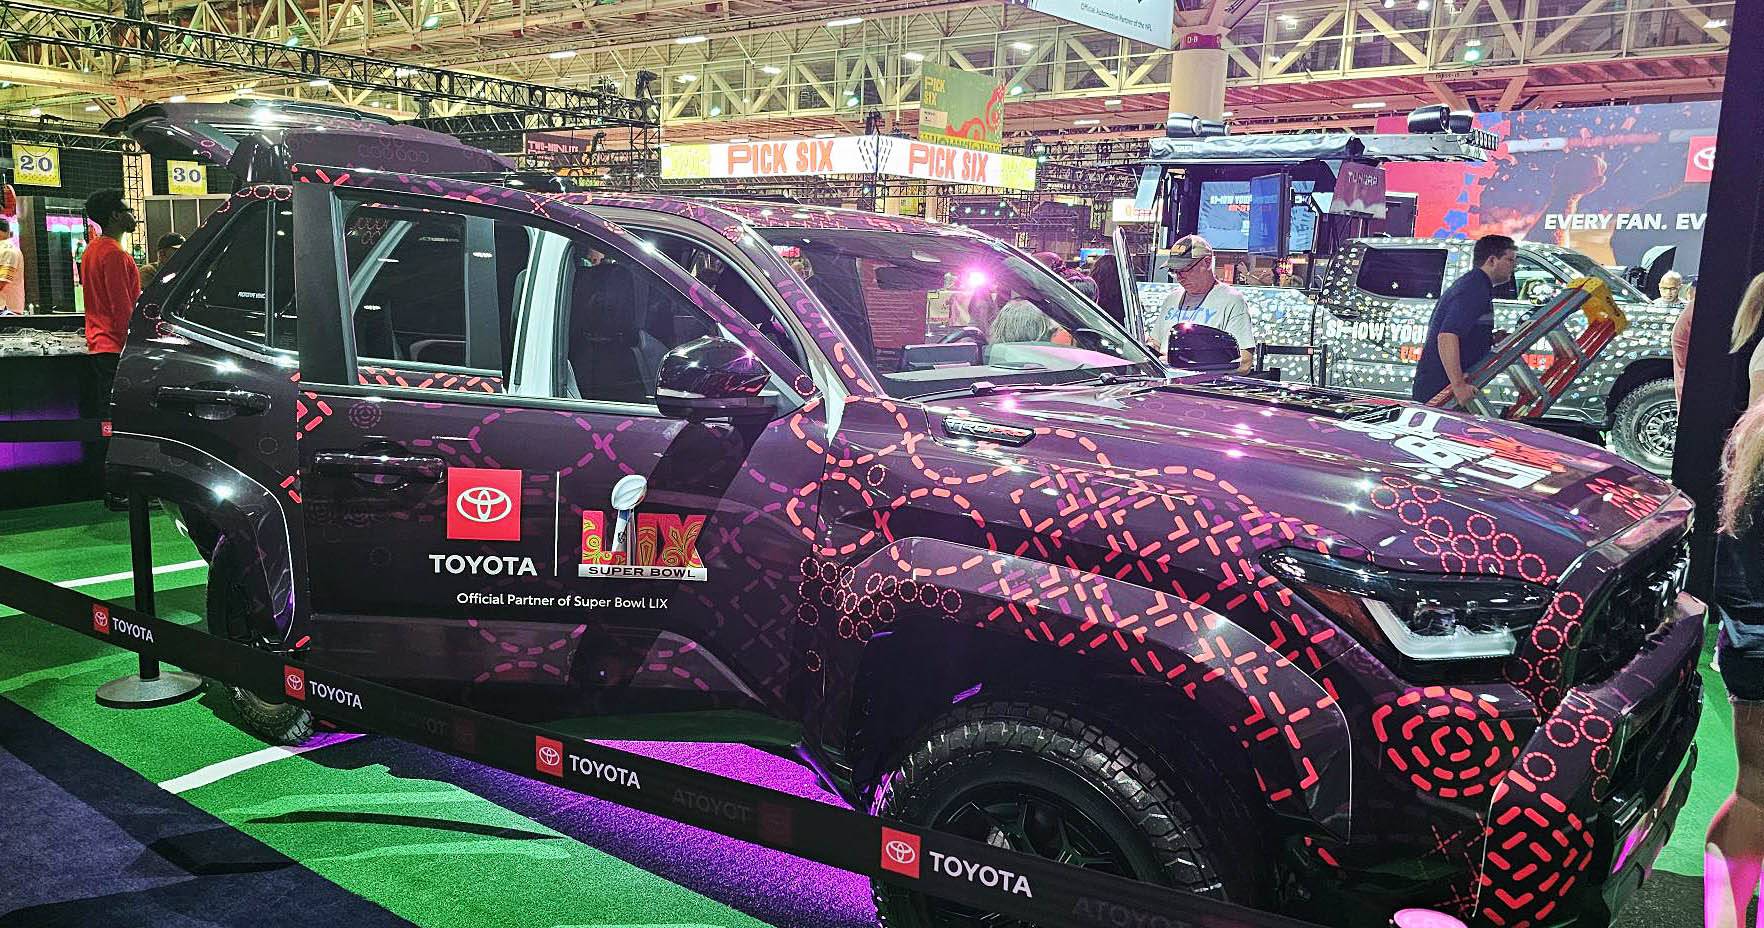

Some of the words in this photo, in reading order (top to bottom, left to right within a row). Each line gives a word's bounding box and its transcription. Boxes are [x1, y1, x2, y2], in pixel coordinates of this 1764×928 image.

[924, 76, 945, 93] PICK
[923, 90, 937, 106] SIX
[20, 155, 53, 172] 20
[727, 143, 788, 175] PICK
[796, 140, 834, 173] SIX
[908, 143, 957, 180] PICK
[961, 151, 988, 182] SIX
[173, 167, 201, 182] 30
[1544, 213, 1613, 230] EVERY
[1616, 213, 1667, 230] FAN.
[1326, 320, 1386, 342] SHOW
[582, 510, 708, 567] LIX
[428, 553, 538, 577] TOYOTA
[588, 566, 644, 578] SUPER
[650, 568, 696, 579] BOWL
[456, 592, 504, 605] Official
[507, 594, 555, 607] Partner
[557, 594, 571, 607] of
[574, 596, 612, 611] Super
[614, 596, 646, 609] Bowl
[649, 598, 668, 609] LIX
[112, 617, 154, 643] TOYOTA
[309, 680, 363, 710] TOYOTA
[568, 754, 641, 790] TOYOTA
[929, 850, 1033, 898] TOYOTA
